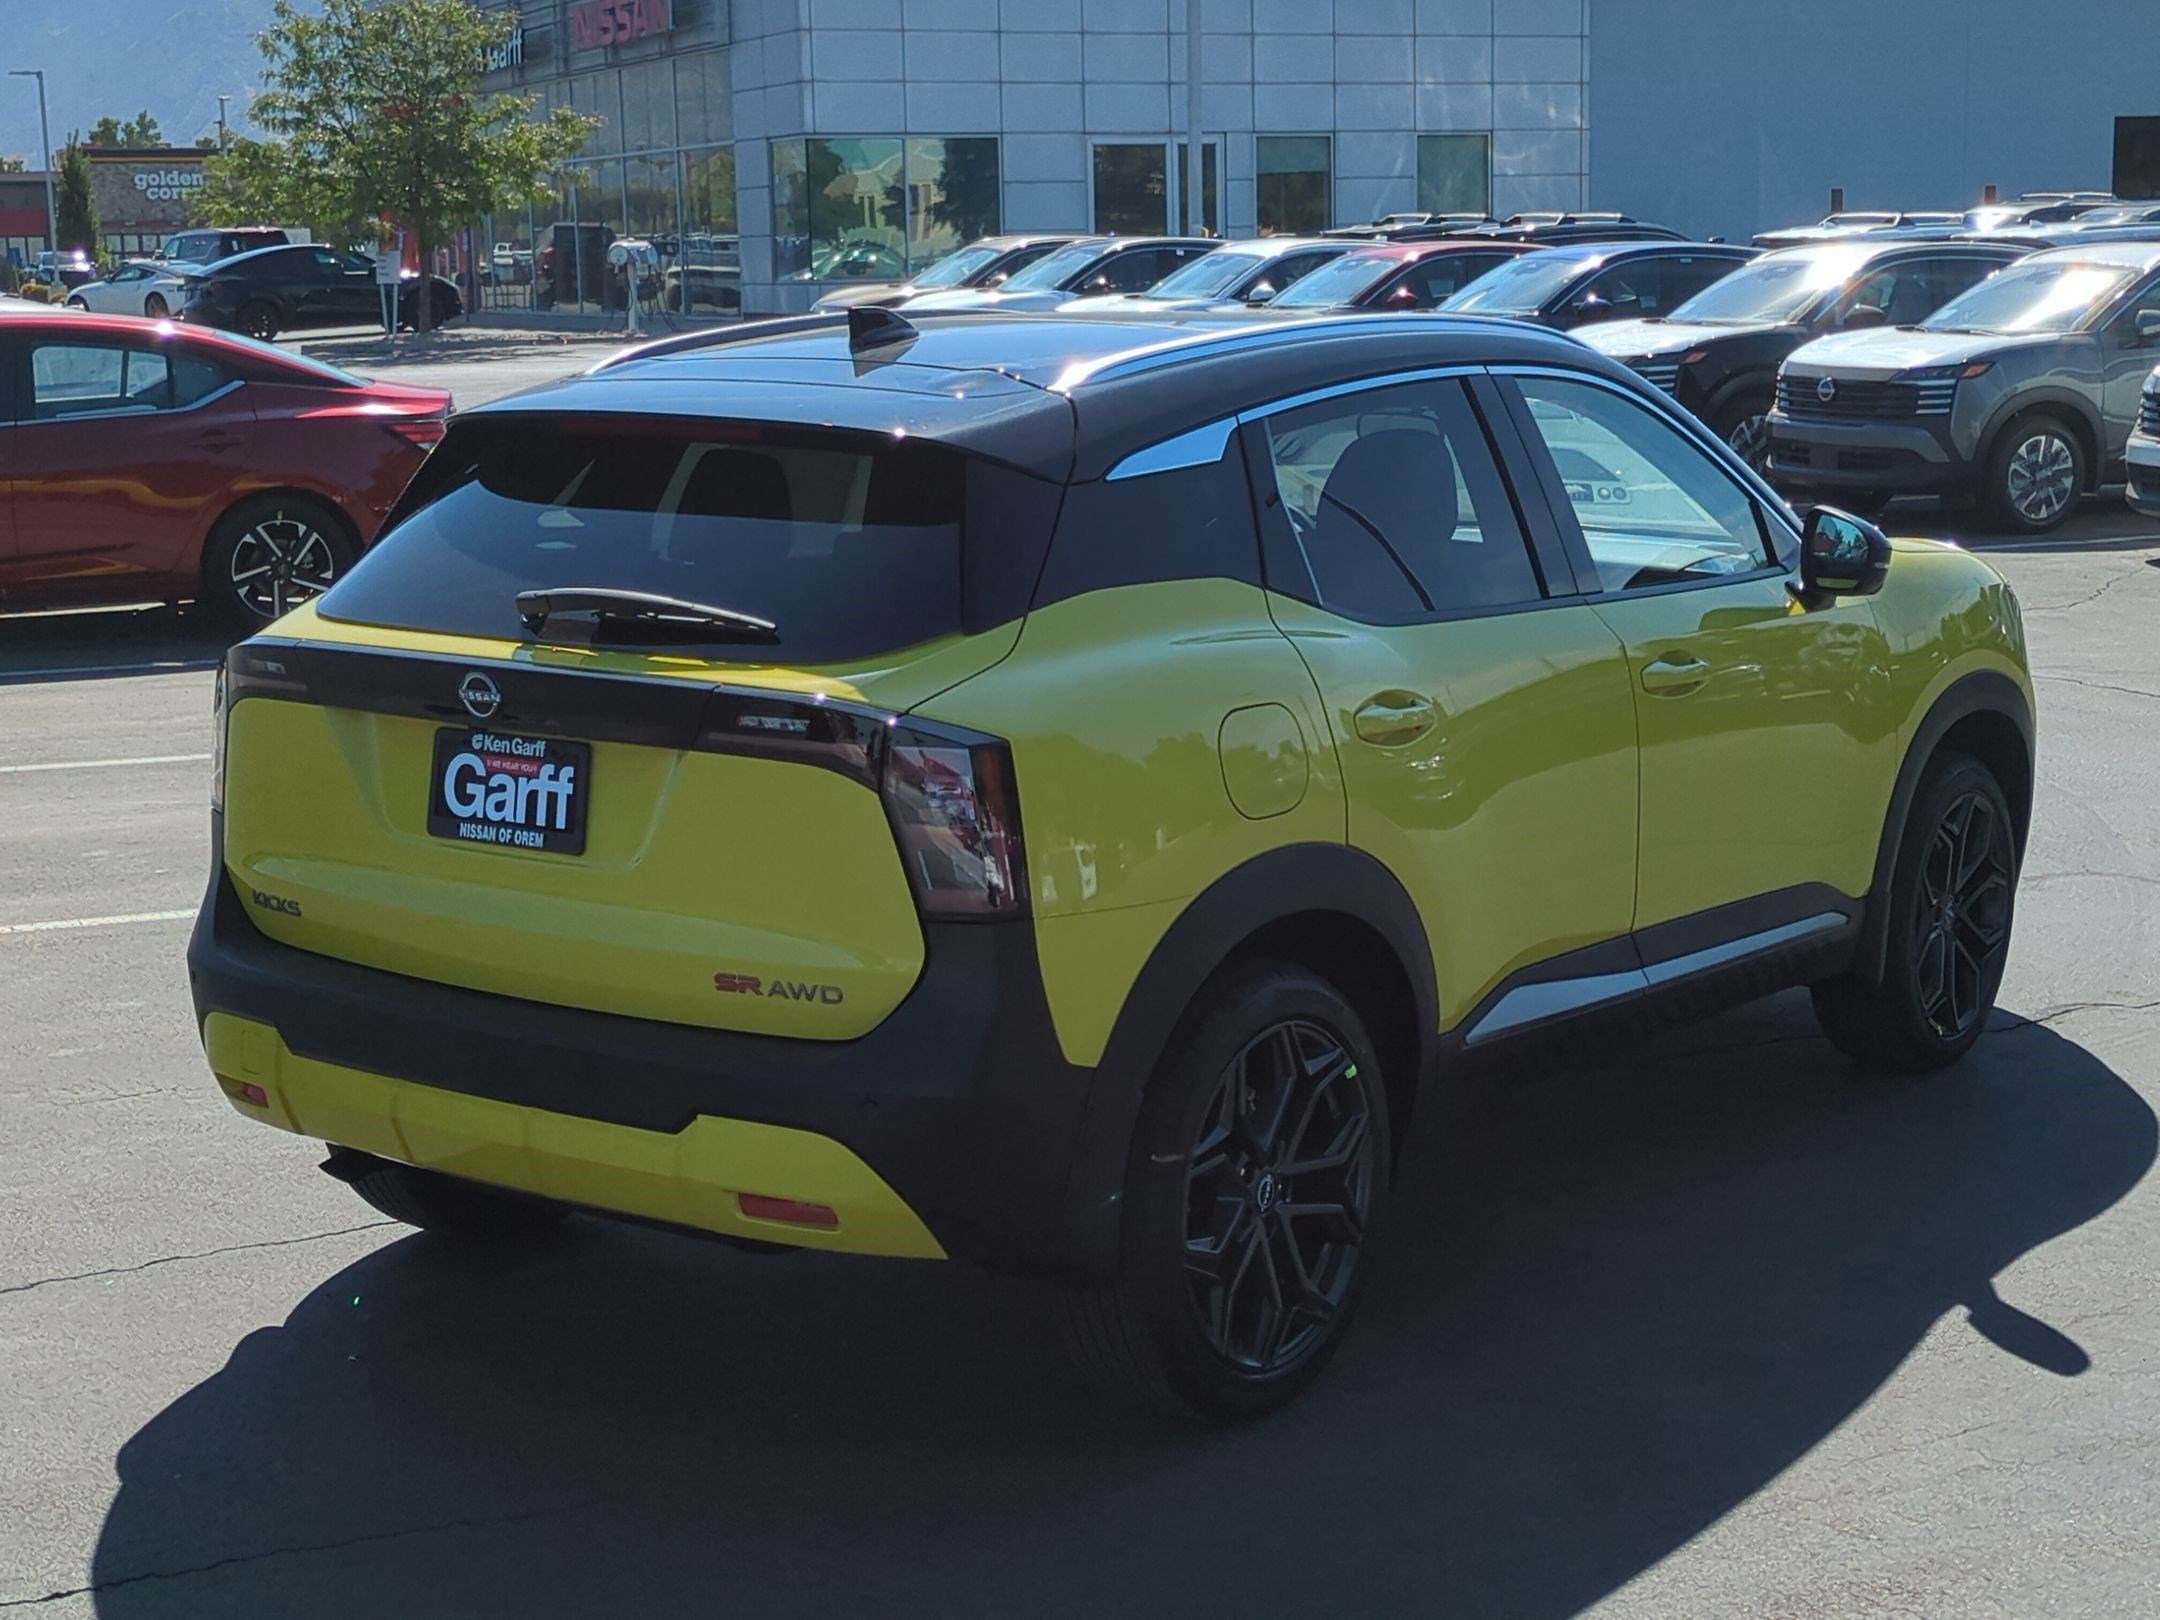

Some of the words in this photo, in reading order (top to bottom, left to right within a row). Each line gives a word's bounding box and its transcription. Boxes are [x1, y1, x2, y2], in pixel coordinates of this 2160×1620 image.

[134, 171, 203, 190] golden
[459, 688, 501, 703] NISSAN
[483, 735, 510, 754] Ken
[511, 738, 546, 757] Garff
[444, 753, 575, 830] Garff
[459, 823, 496, 842] NISSAN
[499, 828, 513, 843] OF
[514, 830, 544, 848] OREM
[252, 890, 302, 916] KICKS
[714, 973, 763, 996] SR
[768, 980, 844, 1005] AWD
